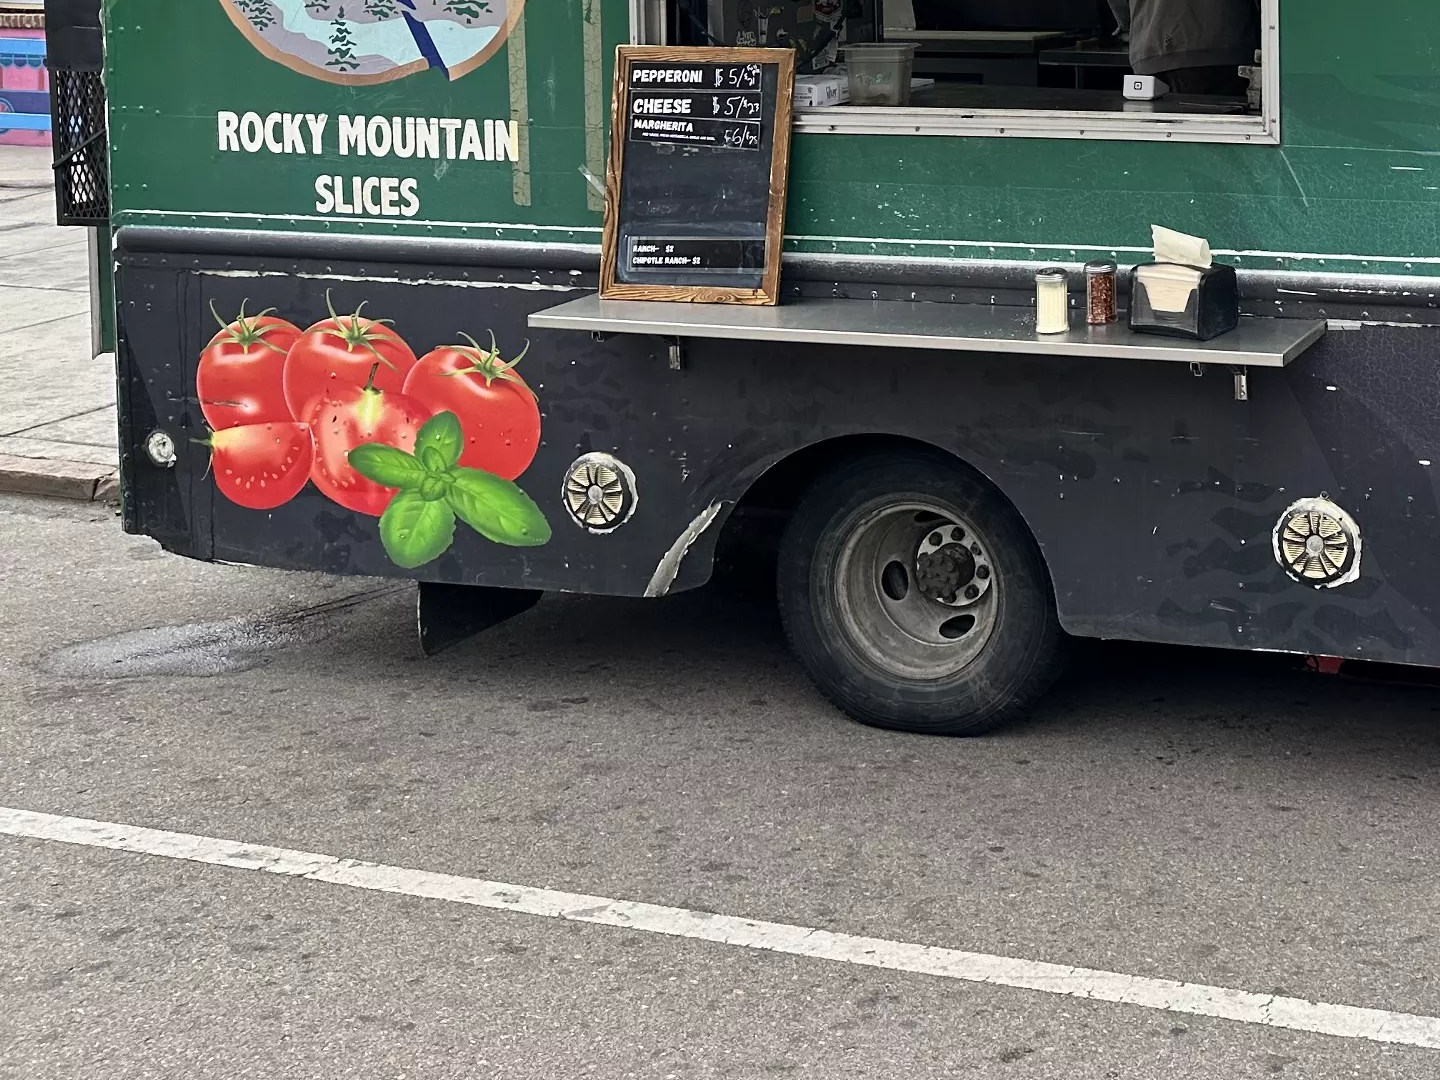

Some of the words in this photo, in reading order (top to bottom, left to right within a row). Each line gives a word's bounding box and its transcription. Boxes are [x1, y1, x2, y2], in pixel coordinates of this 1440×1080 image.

[633, 70, 702, 82] PEPPERONI
[633, 98, 693, 114] CHEESE
[634, 119, 693, 132] MARGHERITA
[217, 110, 328, 155] ROCKY
[338, 114, 519, 162] MOUNTAIN
[314, 174, 420, 217] SLICES
[632, 256, 663, 265] CHIPOTLE
